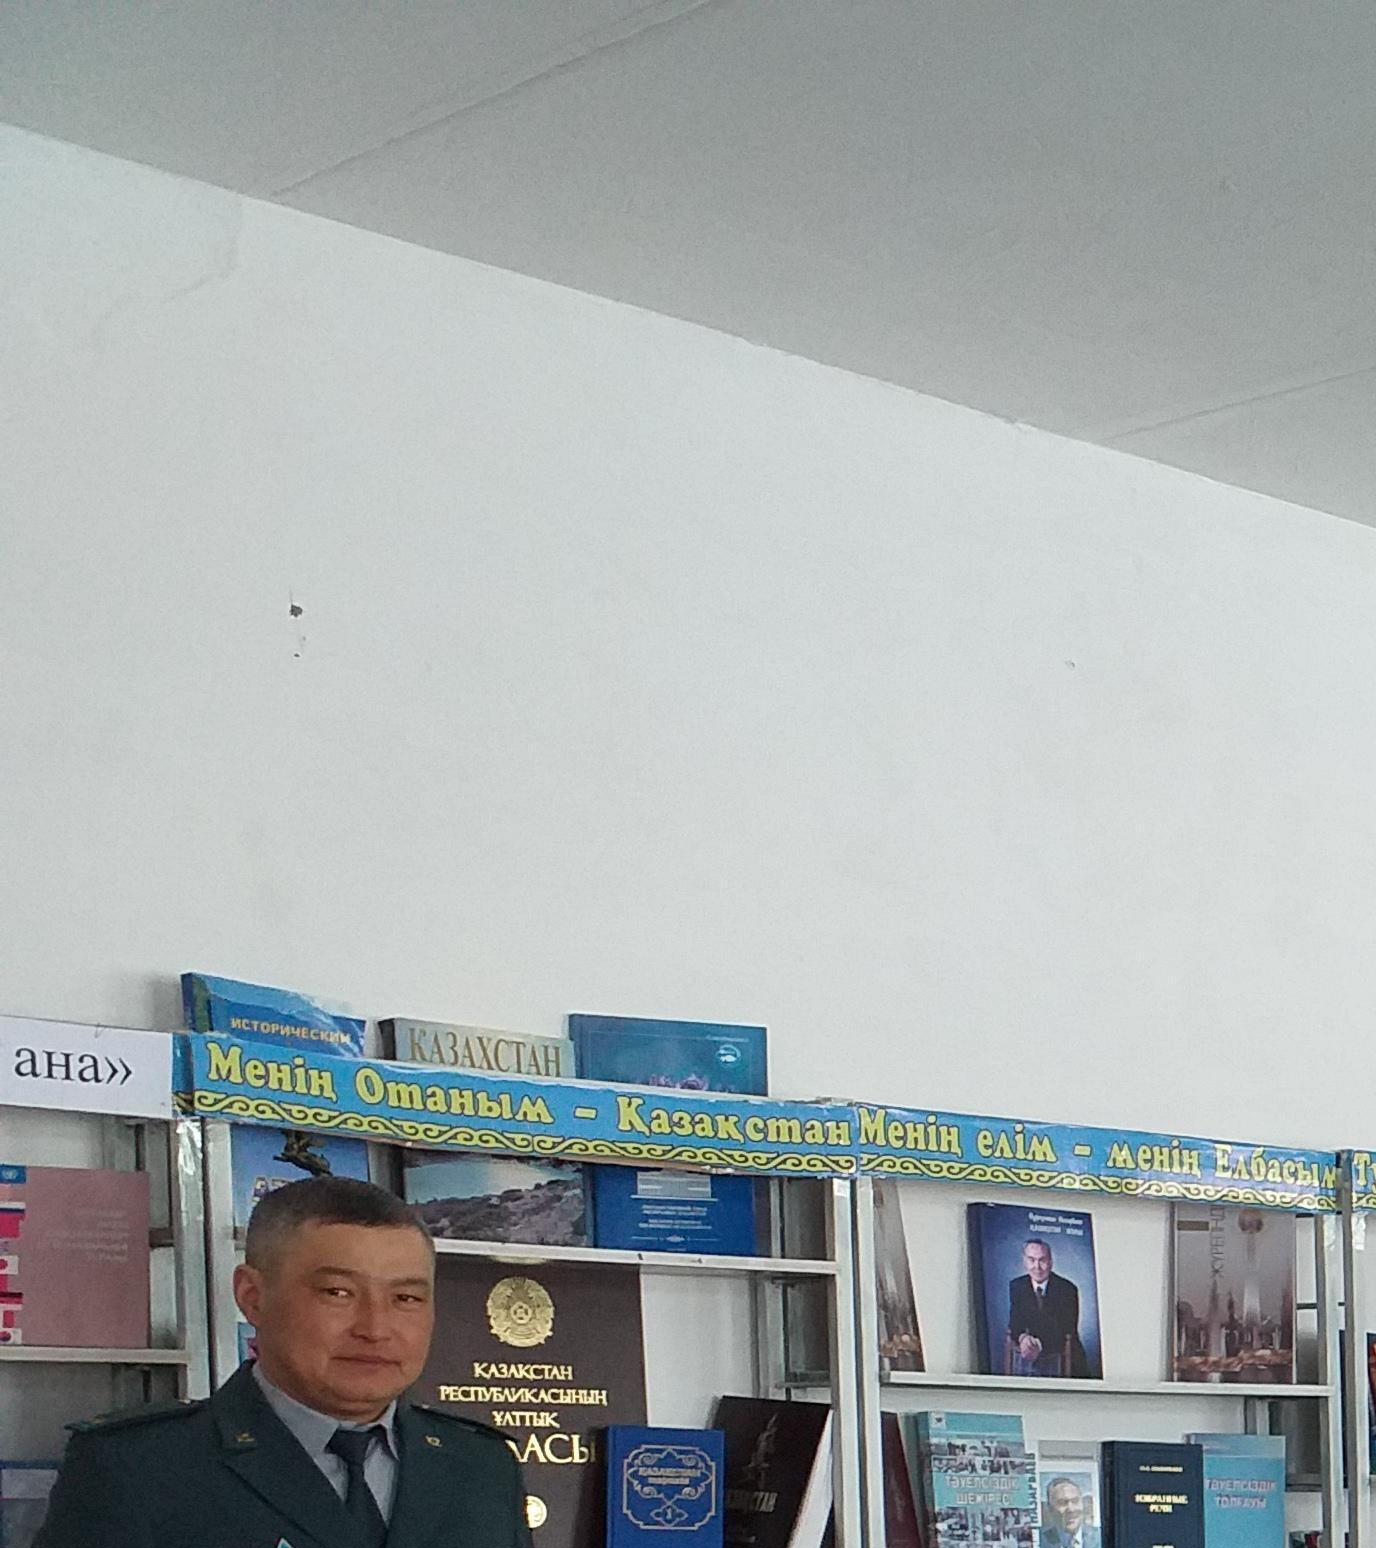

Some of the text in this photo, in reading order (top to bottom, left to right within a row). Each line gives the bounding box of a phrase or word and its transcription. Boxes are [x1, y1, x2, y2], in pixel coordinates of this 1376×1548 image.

[14, 1047, 133, 1086] ана»
[408, 1027, 561, 1078] КАЗАХСТАН
[206, 1041, 337, 1102] Менің
[354, 1067, 555, 1125] Отаным
[616, 1095, 852, 1148] Қазақстан
[858, 1107, 962, 1157] Менің
[976, 1123, 1058, 1163] елім
[1107, 1139, 1202, 1178] менің
[1215, 1143, 1336, 1189] Елбасым
[473, 1362, 573, 1381] ҚАЗАҚСТАН
[439, 1384, 608, 1406] РЕСПУБЛИКАСЫНЫҢ
[492, 1410, 560, 1429] ҰЛТТЫҚ
